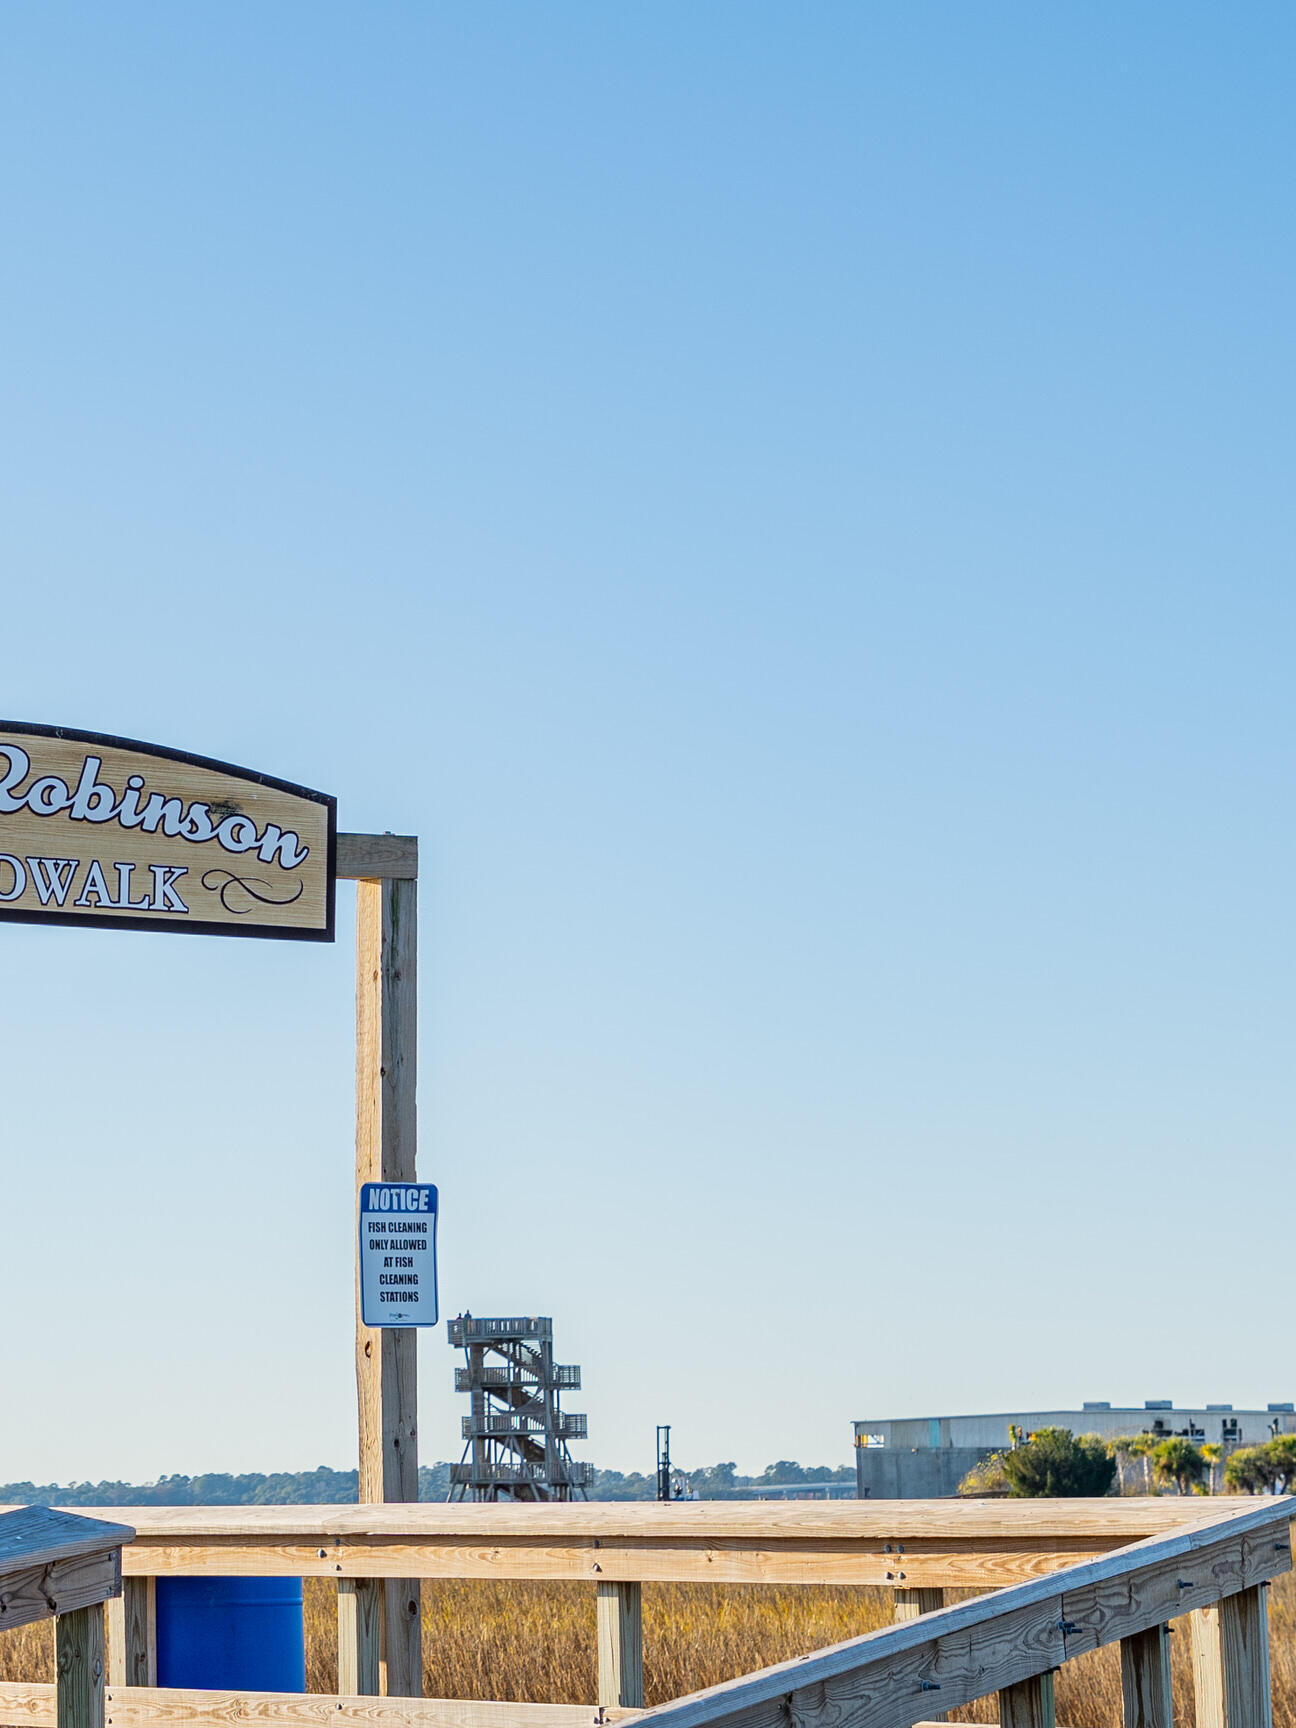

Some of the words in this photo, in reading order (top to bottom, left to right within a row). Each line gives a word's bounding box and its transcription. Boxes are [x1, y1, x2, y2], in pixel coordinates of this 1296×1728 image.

[368, 1188, 429, 1211] NOTICE
[368, 1221, 386, 1233] FISH
[388, 1222, 428, 1233] CLEANING
[369, 1239, 389, 1250] ONLY
[390, 1239, 427, 1250] ALLOWED
[383, 1256, 394, 1268] AT
[395, 1256, 413, 1268] FISH
[379, 1274, 418, 1285] CLEANING
[379, 1291, 419, 1303] STATIONS
